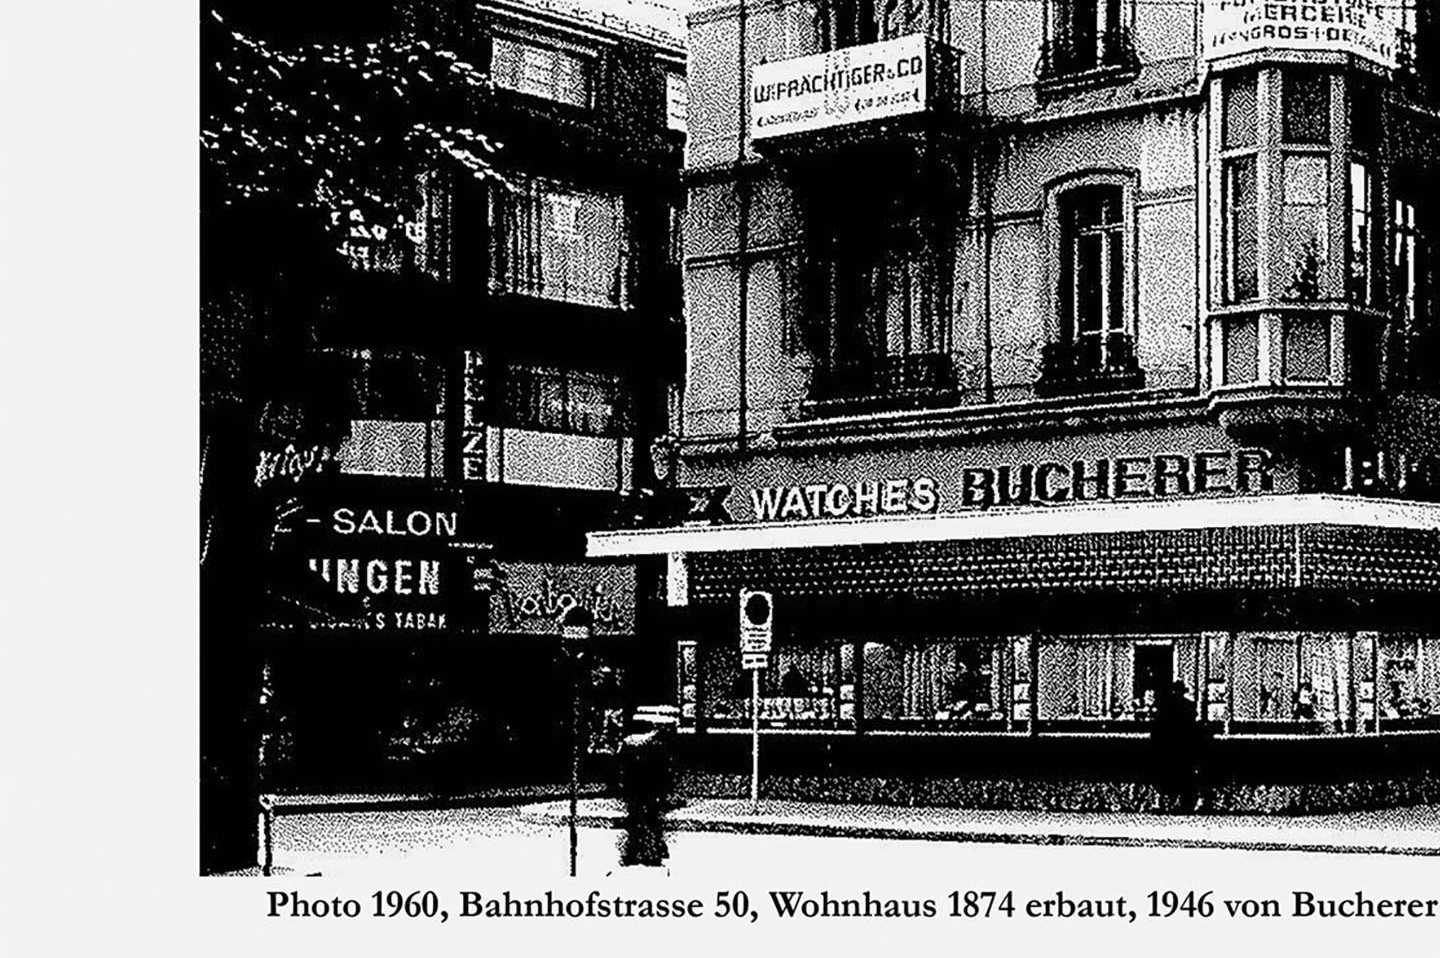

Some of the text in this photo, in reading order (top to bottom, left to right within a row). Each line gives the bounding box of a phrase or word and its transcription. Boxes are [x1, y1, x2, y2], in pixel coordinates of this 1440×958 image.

[751, 476, 938, 520] WATCHES
[962, 448, 1274, 507] BUCHERER
[332, 507, 458, 536] SALON
